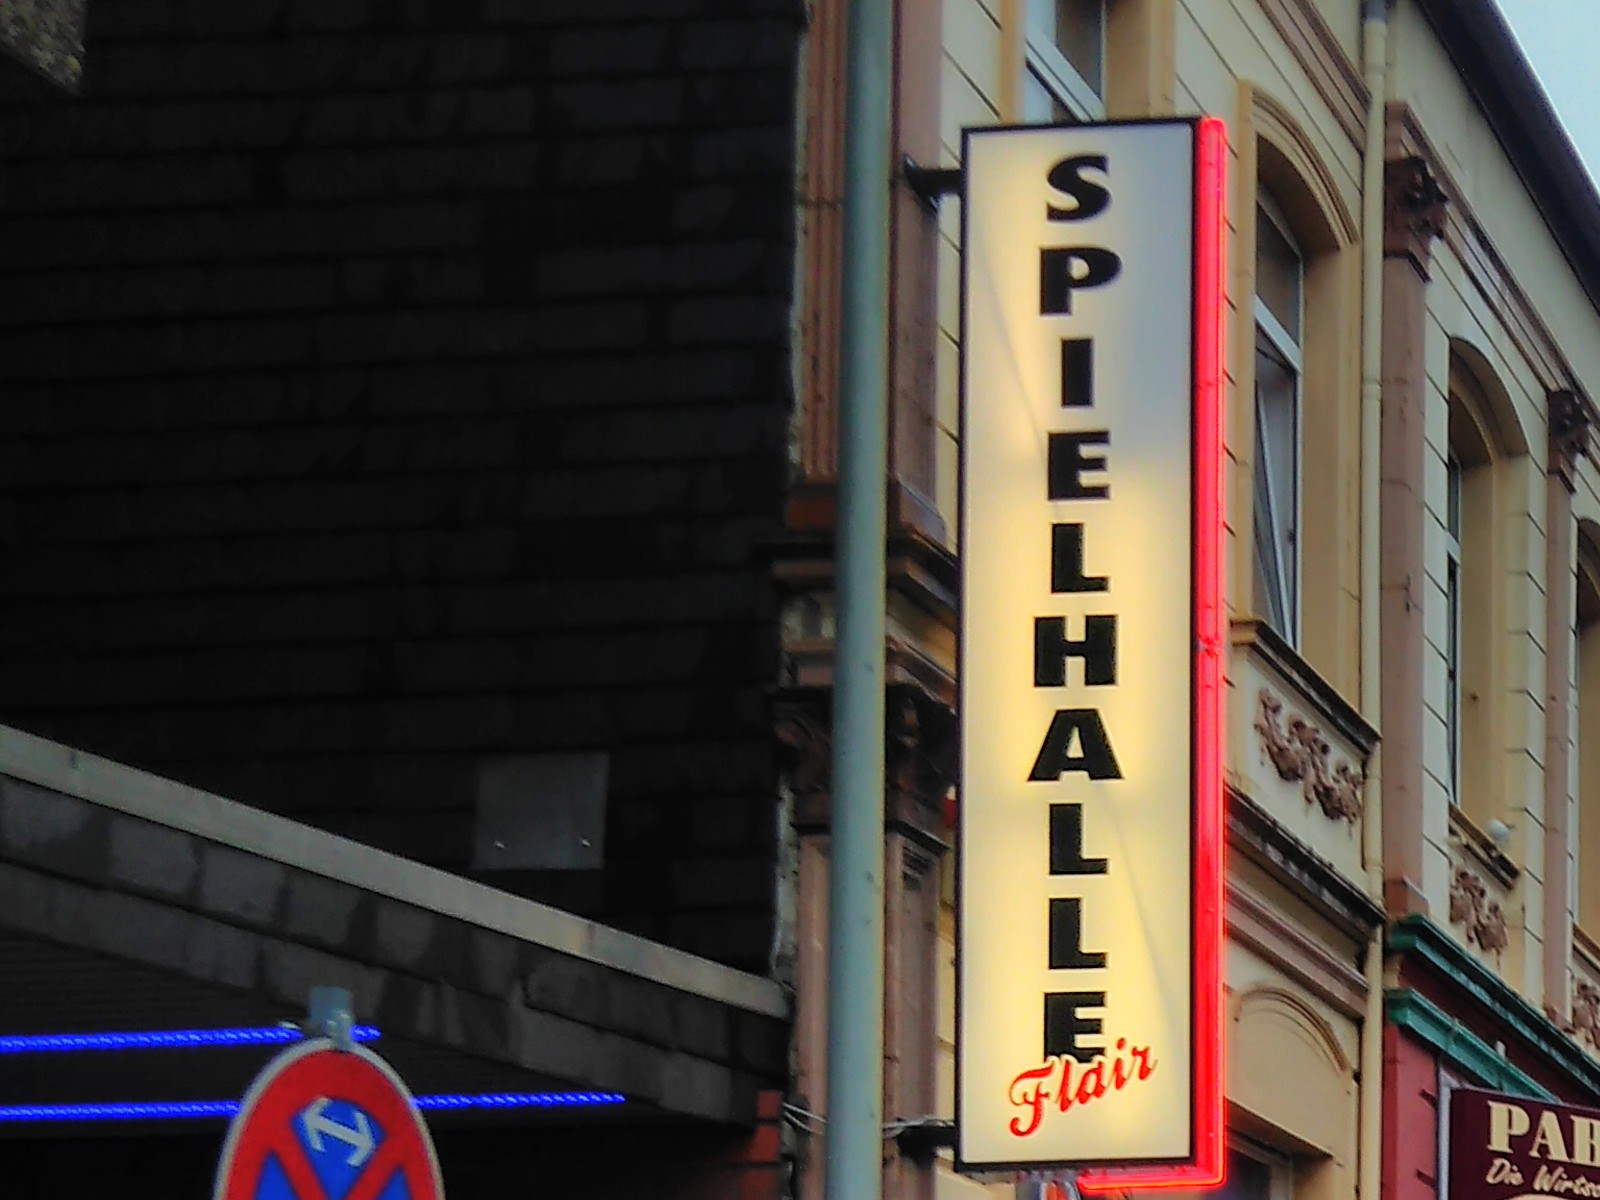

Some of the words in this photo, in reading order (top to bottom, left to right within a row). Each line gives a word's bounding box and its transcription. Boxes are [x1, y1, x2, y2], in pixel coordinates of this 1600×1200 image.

[1027, 154, 1124, 1064] SPIELHALLE
[1008, 1037, 1157, 1138] Flair
[1485, 1158, 1524, 1187] Die
